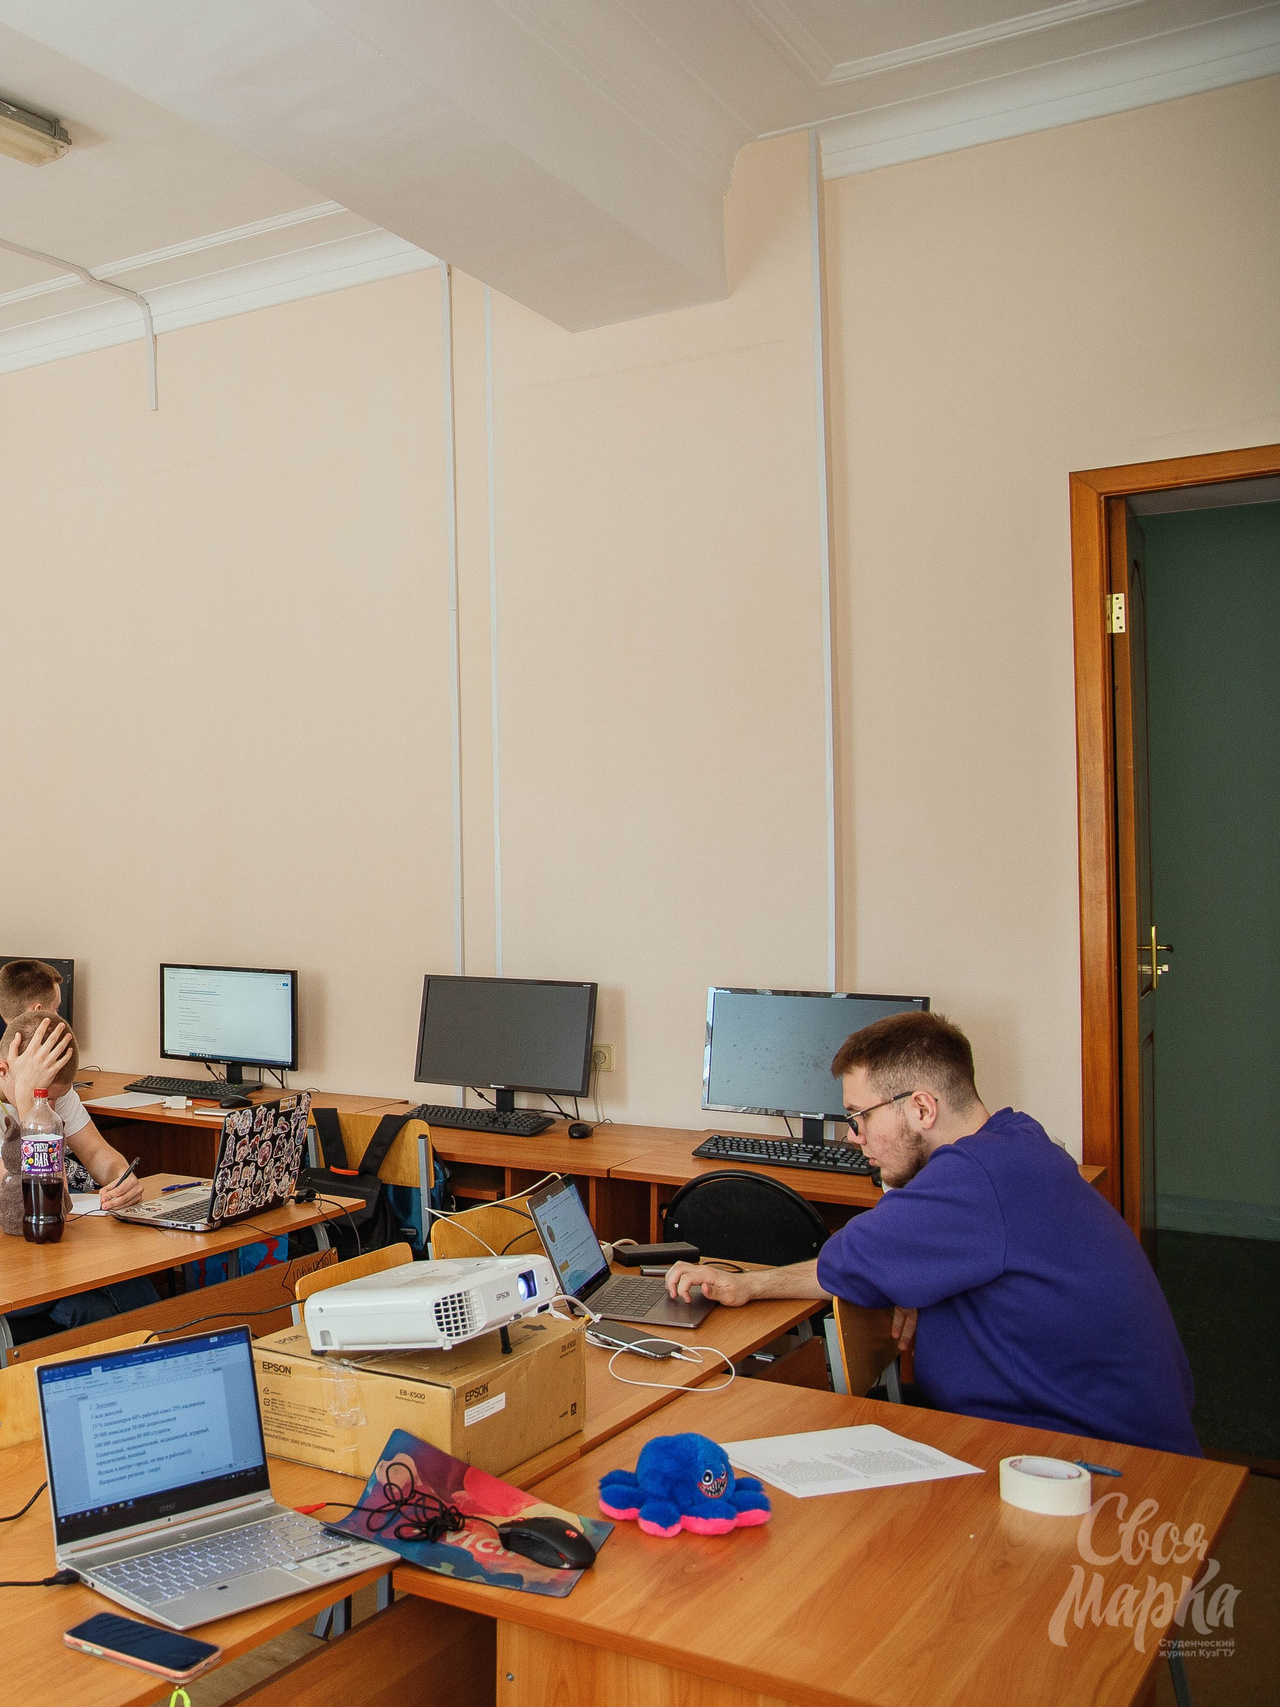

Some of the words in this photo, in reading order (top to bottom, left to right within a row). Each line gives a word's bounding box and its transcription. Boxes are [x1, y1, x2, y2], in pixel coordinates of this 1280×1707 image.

[34, 1143, 49, 1152] FRESH
[34, 1152, 50, 1168] BAR
[496, 1290, 510, 1301] EPSON
[262, 1361, 292, 1374] EPSON
[400, 1389, 426, 1400] EB-X500
[465, 1382, 489, 1402] EPSON
